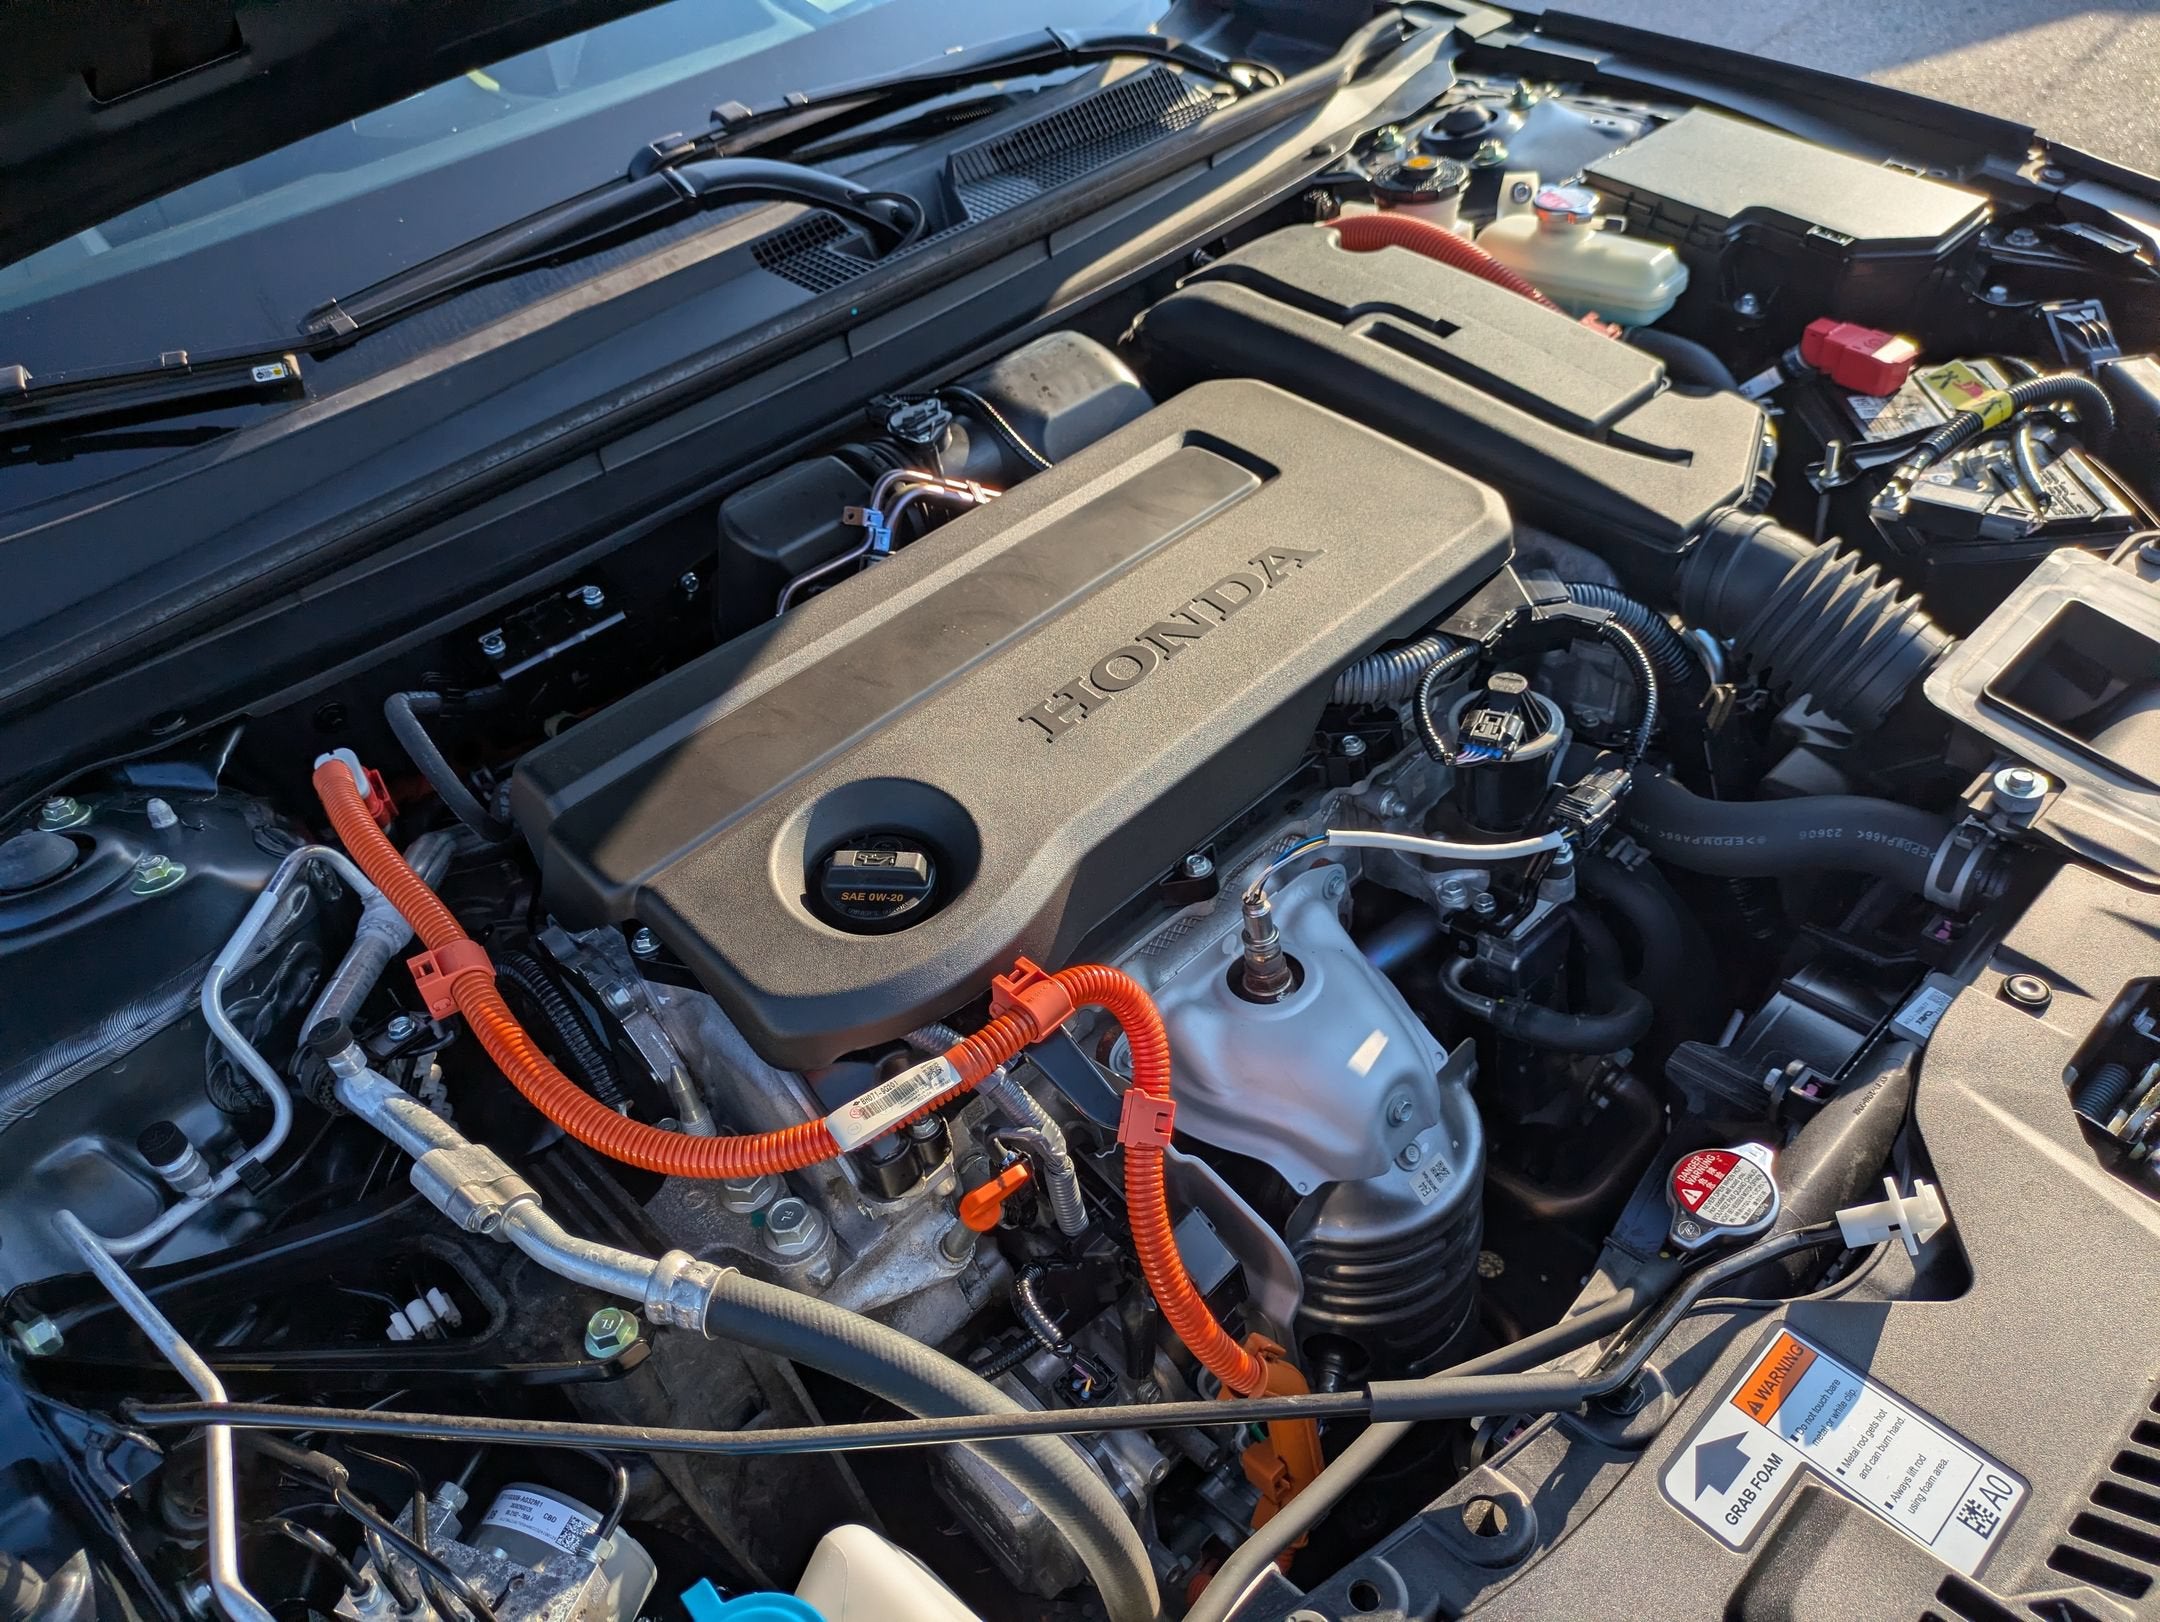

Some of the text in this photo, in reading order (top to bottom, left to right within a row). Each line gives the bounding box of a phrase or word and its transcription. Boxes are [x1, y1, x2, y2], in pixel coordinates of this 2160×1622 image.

[1018, 546, 1328, 743] HONDA
[841, 891, 904, 903] SAE 0W-20
[1677, 1155, 1703, 1182] DANGER
[1686, 1154, 1715, 1185] WARNUNG
[1714, 1185, 1725, 1198] OPEN
[1754, 1344, 1804, 1401] WARNING
[1796, 1379, 1841, 1436] Do not touch bare
[1812, 1388, 1858, 1446] metal or white clip.
[1842, 1408, 1888, 1469] Metal rod gets hot
[1859, 1416, 1906, 1480] and can burn hand.
[1725, 1452, 1784, 1526] GRAB FOAM
[1890, 1453, 1927, 1503] Always lift rod
[1907, 1458, 1949, 1514] using foam area.
[542, 1512, 557, 1524] CBD
